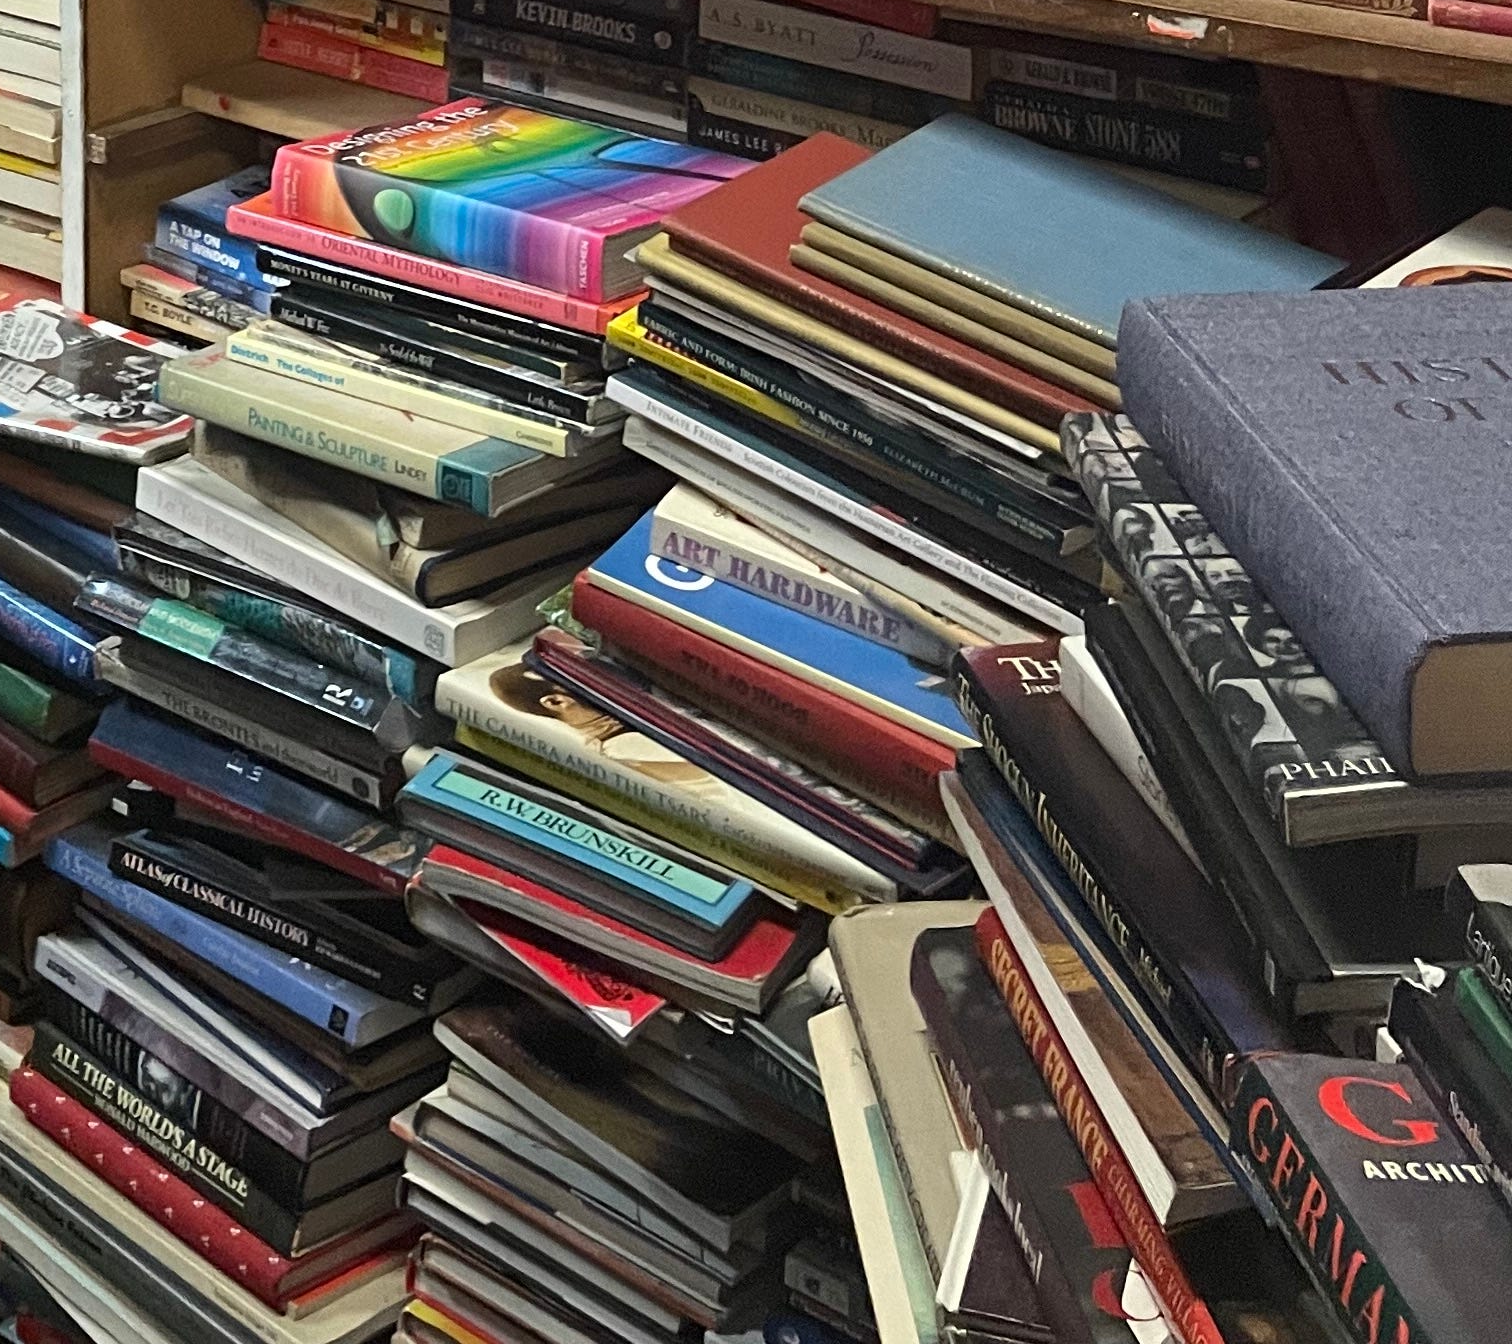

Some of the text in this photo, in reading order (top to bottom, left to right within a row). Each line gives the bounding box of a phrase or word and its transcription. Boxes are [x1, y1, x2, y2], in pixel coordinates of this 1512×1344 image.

[574, 10, 637, 44] BROOKS
[301, 105, 488, 155] Designing the
[321, 236, 382, 268] ORIENTAL
[579, 239, 590, 290] TASCHEN
[249, 406, 387, 472] PAINTING SCULPTURE
[662, 532, 901, 645] ART HARDWARE
[531, 814, 675, 881] BRUNSKILL
[121, 852, 162, 880] ATLAS
[172, 876, 247, 916] CLASSICAL
[248, 907, 309, 947] HISTORY
[991, 937, 1047, 1061] SECRET
[1043, 1049, 1109, 1170] FRANCE
[52, 1043, 249, 1197] ALL THE WORLD'S A STAGE
[1318, 1076, 1440, 1147] G
